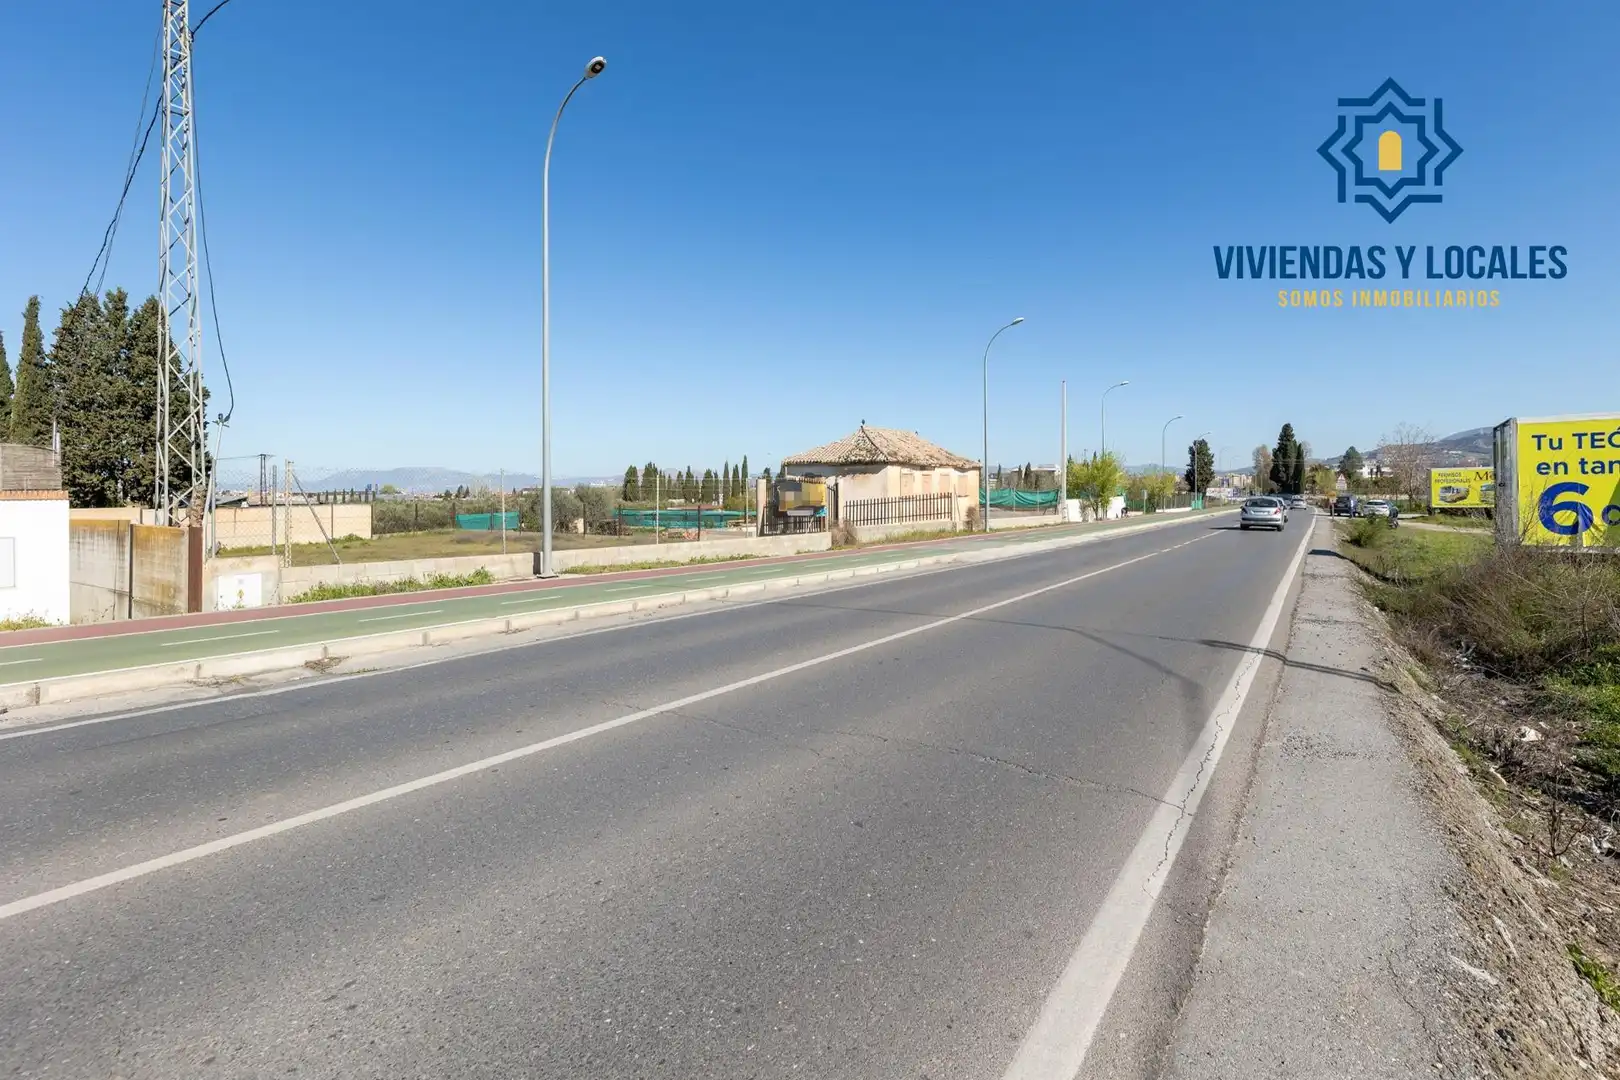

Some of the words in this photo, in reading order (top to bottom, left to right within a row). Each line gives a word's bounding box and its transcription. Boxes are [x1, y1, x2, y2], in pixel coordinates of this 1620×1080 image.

[1532, 434, 1563, 451] Tu
[1536, 461, 1569, 476] en
[1538, 481, 1594, 536] 6
